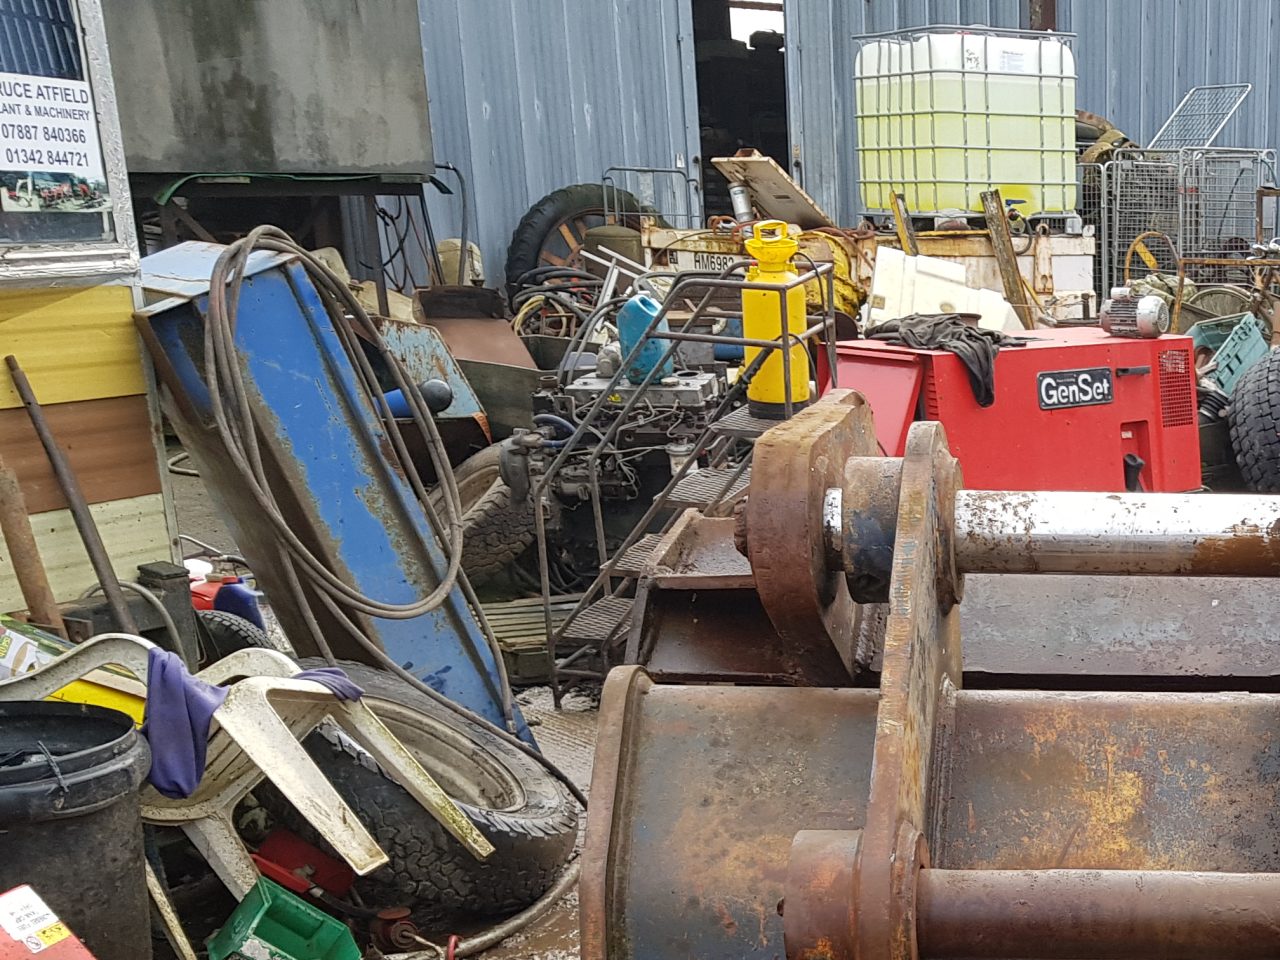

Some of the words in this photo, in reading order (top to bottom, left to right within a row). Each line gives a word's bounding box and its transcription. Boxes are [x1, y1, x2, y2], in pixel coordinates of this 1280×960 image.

[36, 85, 89, 104] ATFIELD
[24, 104, 32, 116] &
[34, 105, 90, 121] MACHINERY
[1, 123, 38, 141] 07887
[43, 126, 86, 144] 840366
[6, 148, 44, 165] 01342
[47, 150, 89, 167] 844721
[1041, 373, 1110, 404] GenSet
